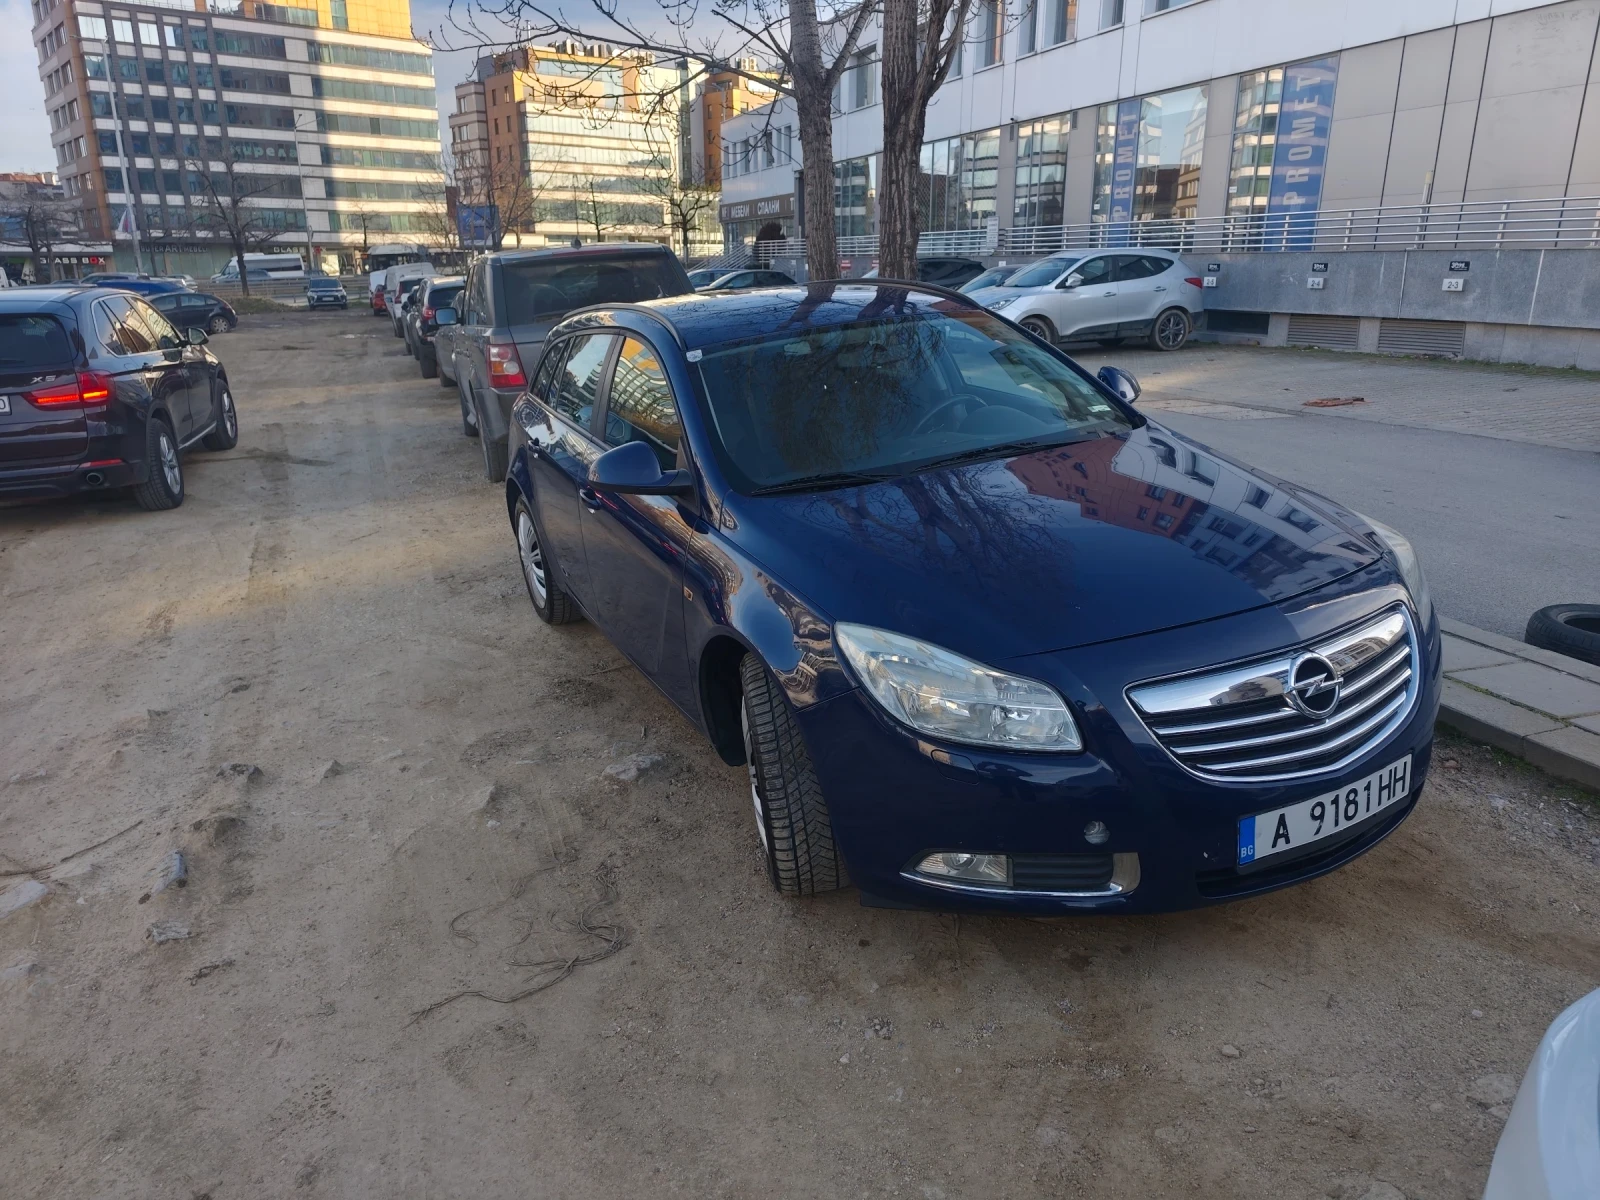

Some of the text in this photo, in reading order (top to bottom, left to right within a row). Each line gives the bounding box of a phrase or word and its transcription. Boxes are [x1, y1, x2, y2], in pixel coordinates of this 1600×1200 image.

[1283, 75, 1321, 205] PROMET
[1112, 113, 1138, 221] PROMET
[731, 204, 750, 218] МЕБЕЛИ
[757, 199, 780, 215] СПАЛНИ
[82, 255, 106, 265] BOX
[1310, 279, 1321, 287] 2-4
[1447, 281, 1459, 289] 2-3
[30, 374, 57, 384] X5
[1271, 812, 1291, 849] A
[1240, 844, 1254, 858] BG
